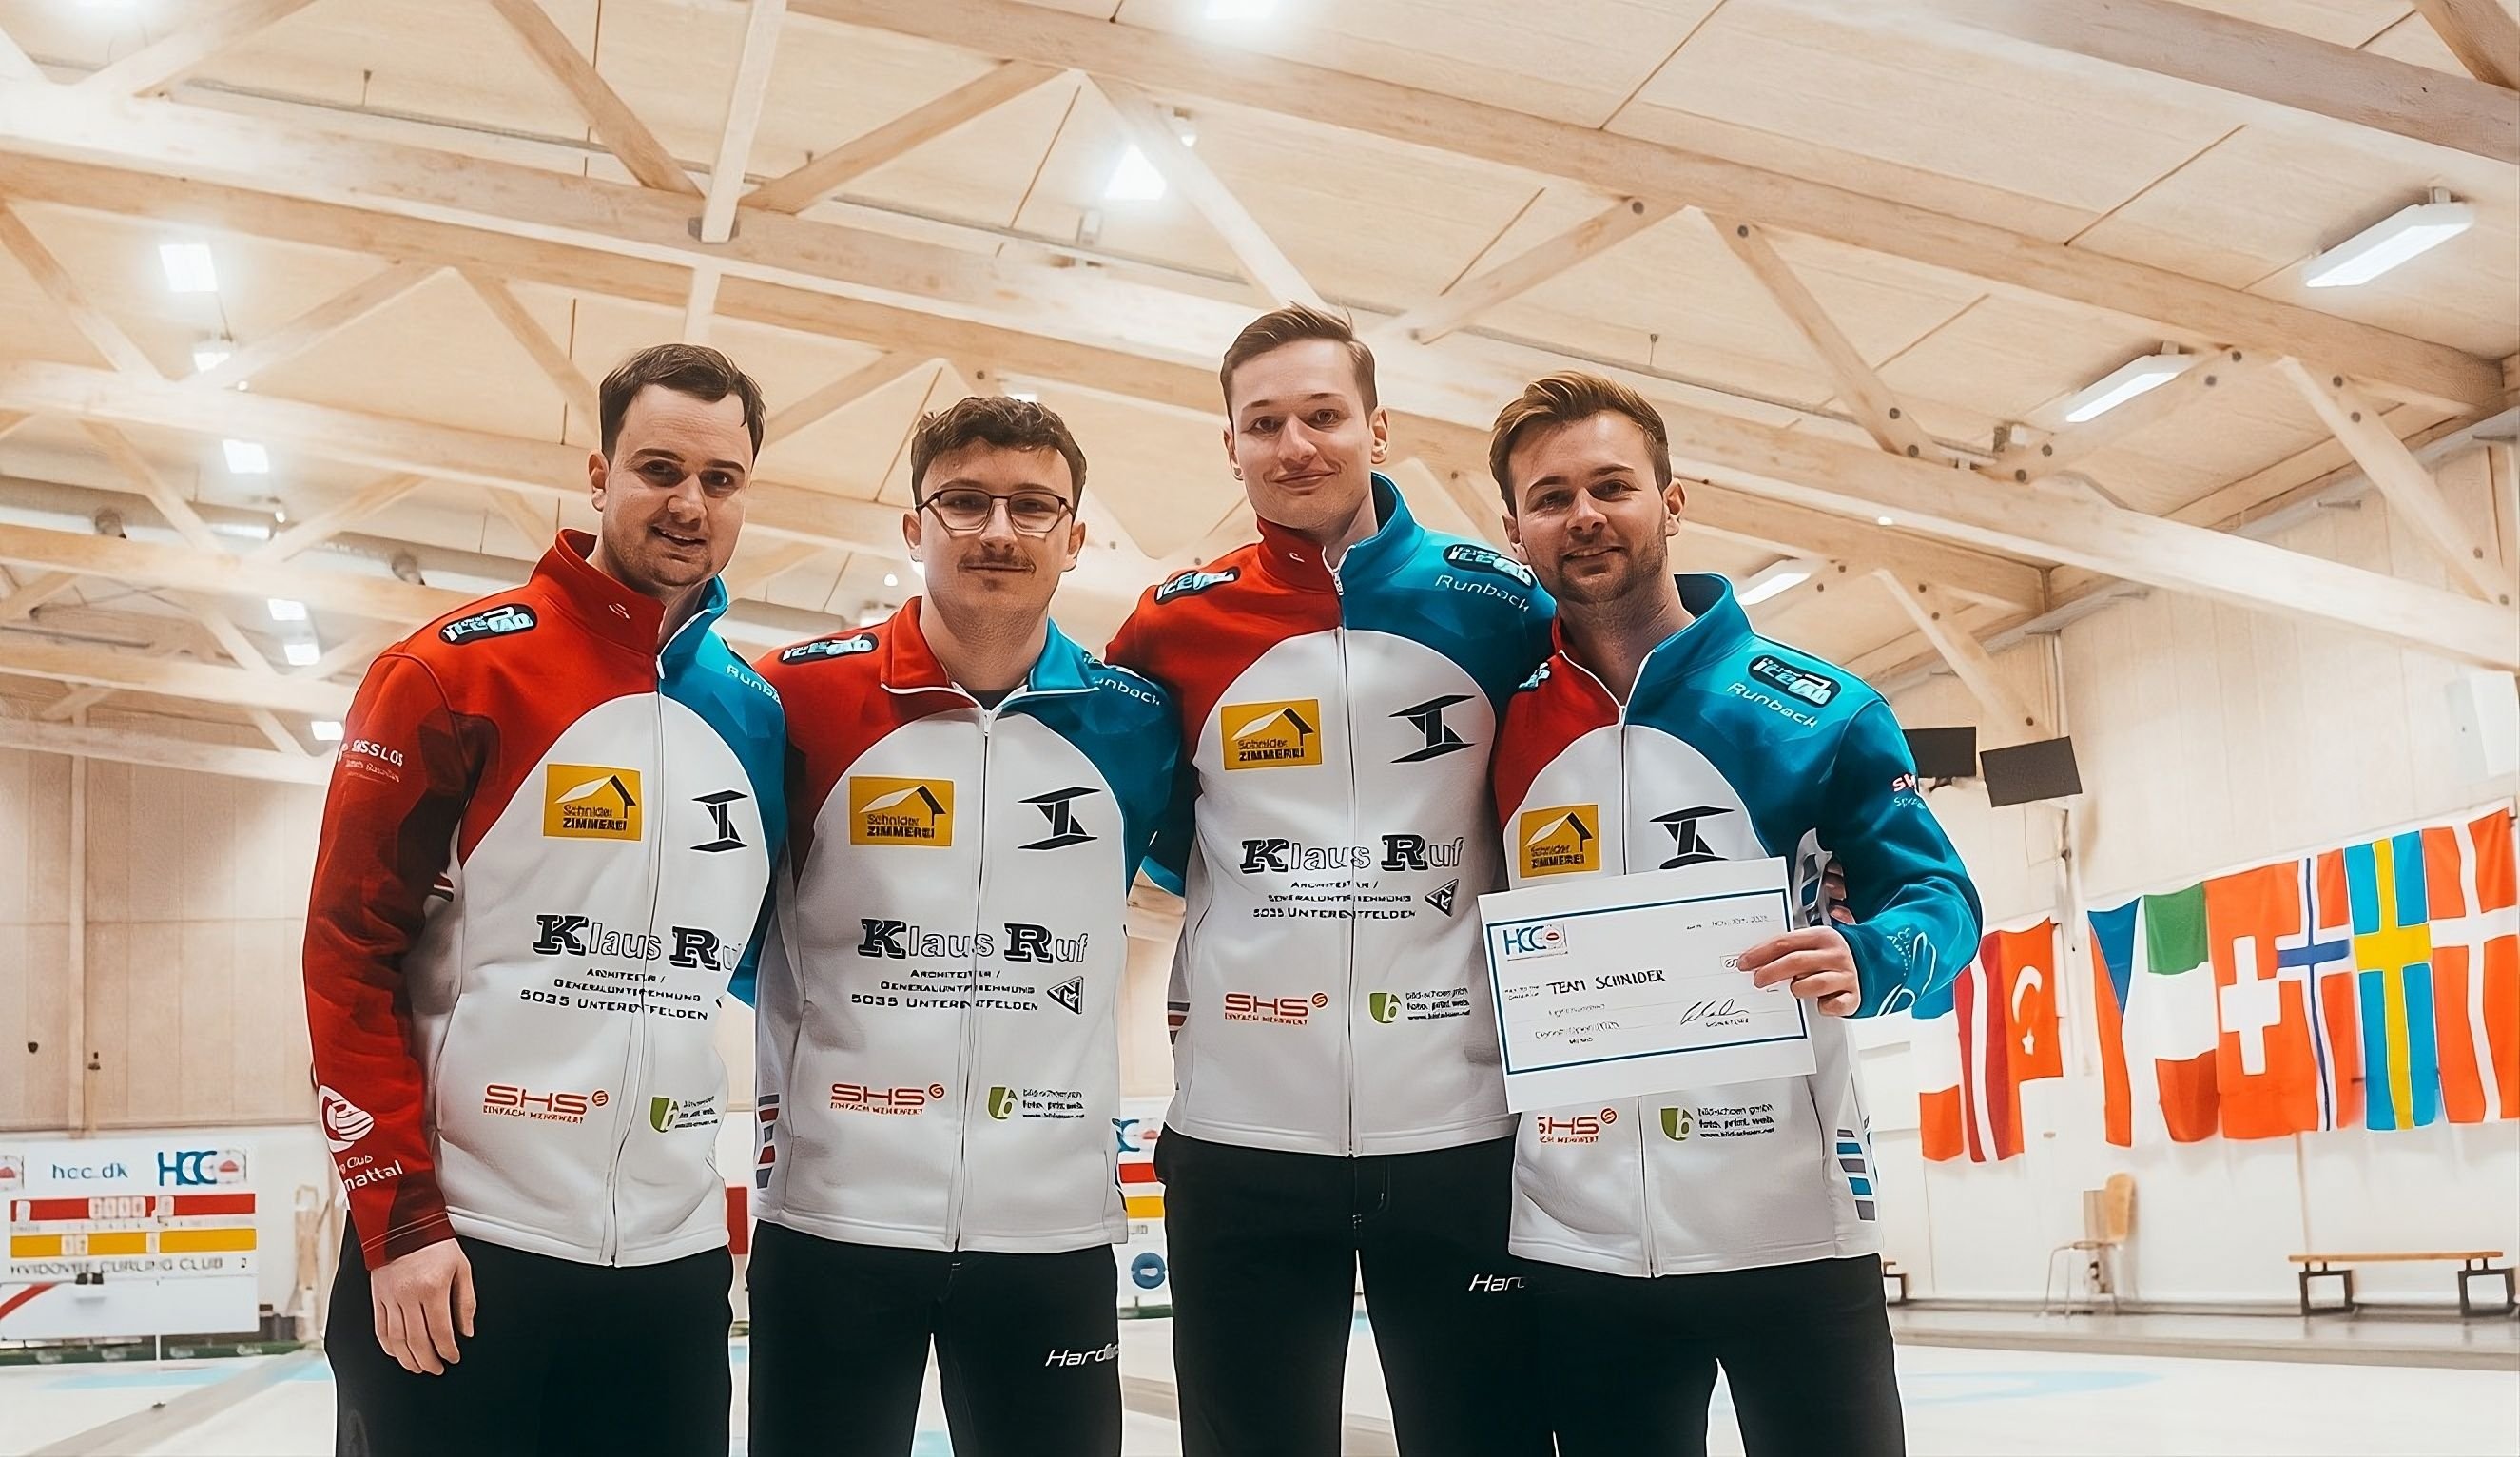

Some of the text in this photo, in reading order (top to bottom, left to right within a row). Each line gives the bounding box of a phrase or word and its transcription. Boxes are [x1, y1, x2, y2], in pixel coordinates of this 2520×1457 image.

[1434, 574, 1530, 612] Runback
[1727, 682, 1819, 728] Runback
[1239, 834, 1464, 874] Klaus Ruf
[532, 914, 662, 962] Klaus
[857, 918, 1089, 964] Klaus Ruf
[1502, 925, 1547, 955] HCC
[1546, 979, 1587, 995] TEAM
[1225, 993, 1309, 1017] SHS
[483, 1084, 589, 1116] SHS
[830, 1083, 926, 1106] SHS
[158, 1150, 218, 1187] HCC
[179, 1258, 223, 1271] CLUB
